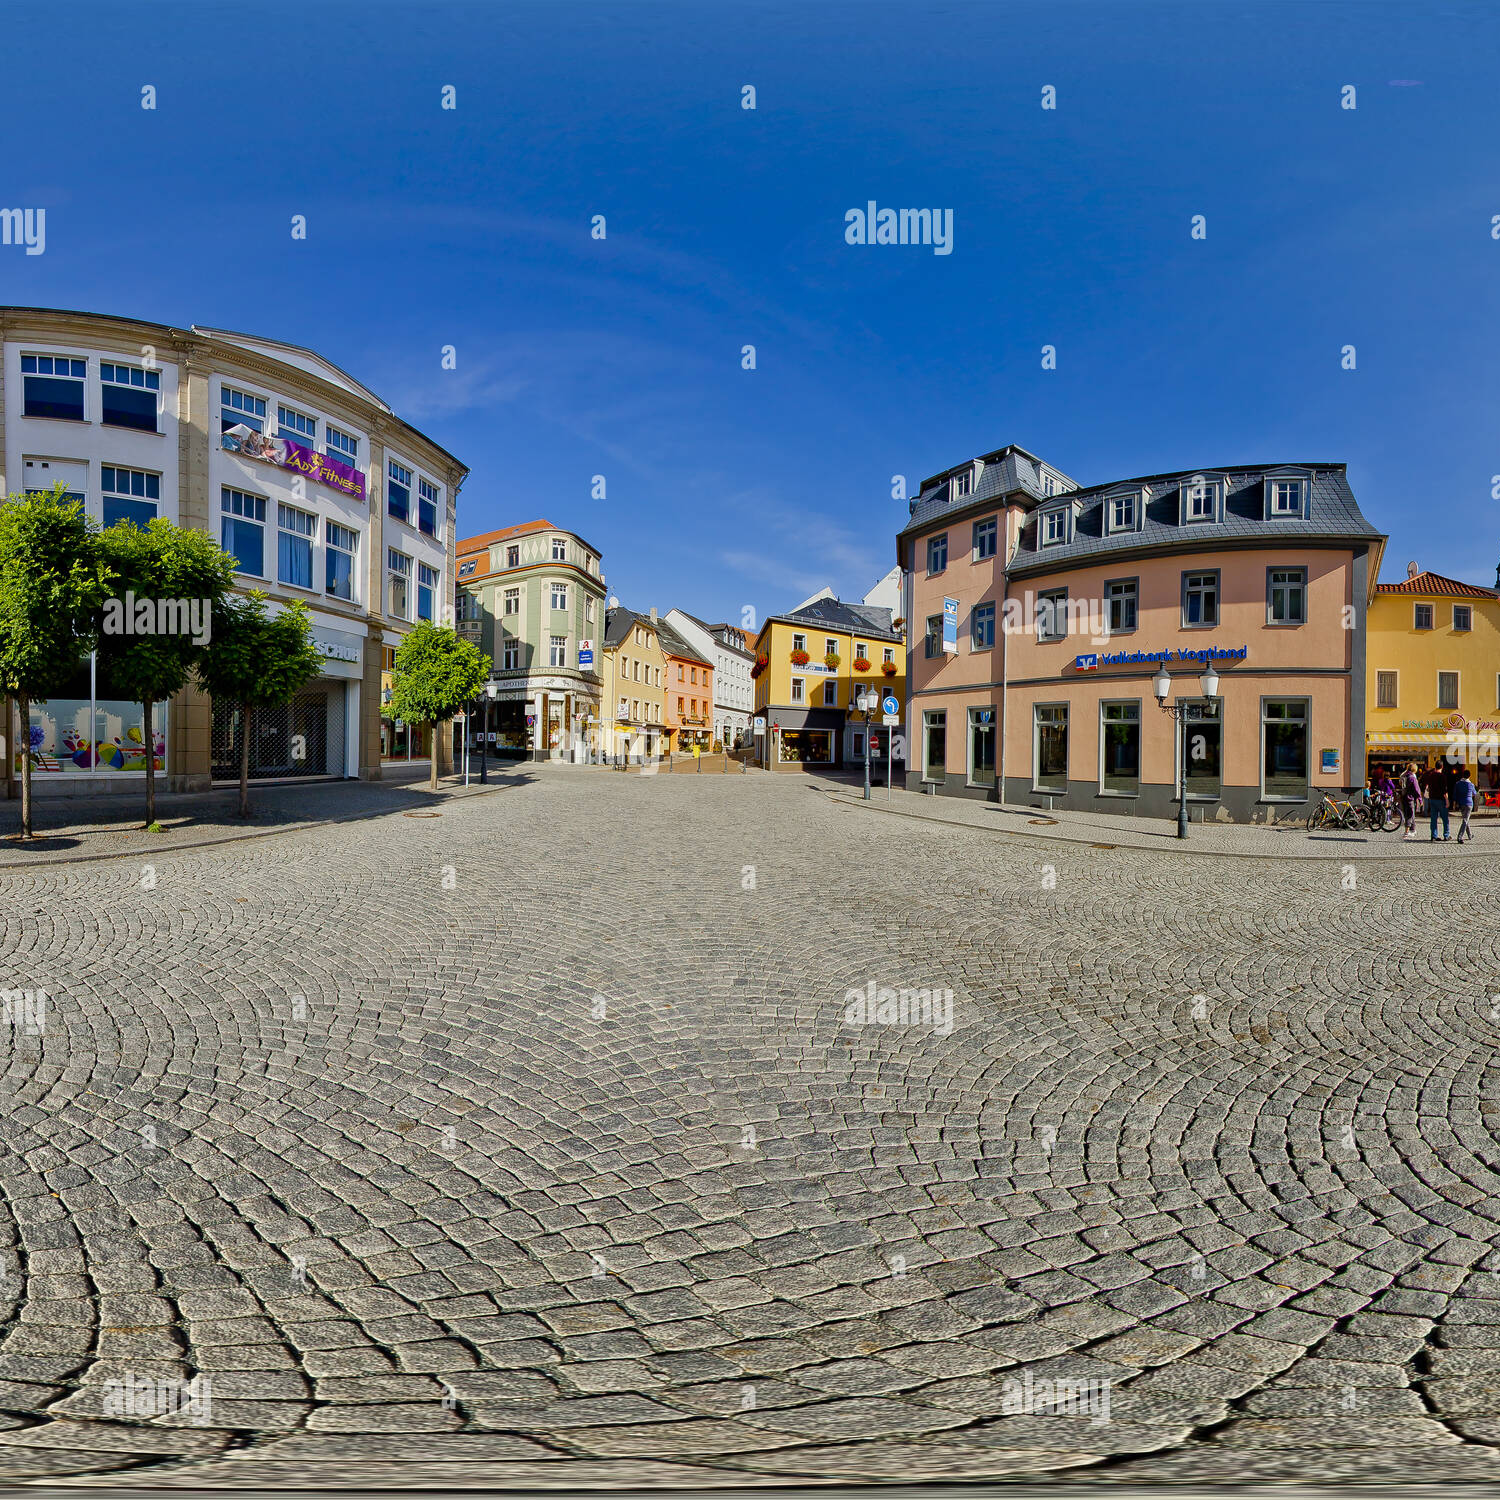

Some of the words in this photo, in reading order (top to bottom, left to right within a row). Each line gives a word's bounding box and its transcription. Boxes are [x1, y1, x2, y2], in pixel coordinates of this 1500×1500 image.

[286, 450, 318, 474] LADY
[1102, 648, 1173, 665] Volksbank
[1177, 645, 1247, 663] Vogtland
